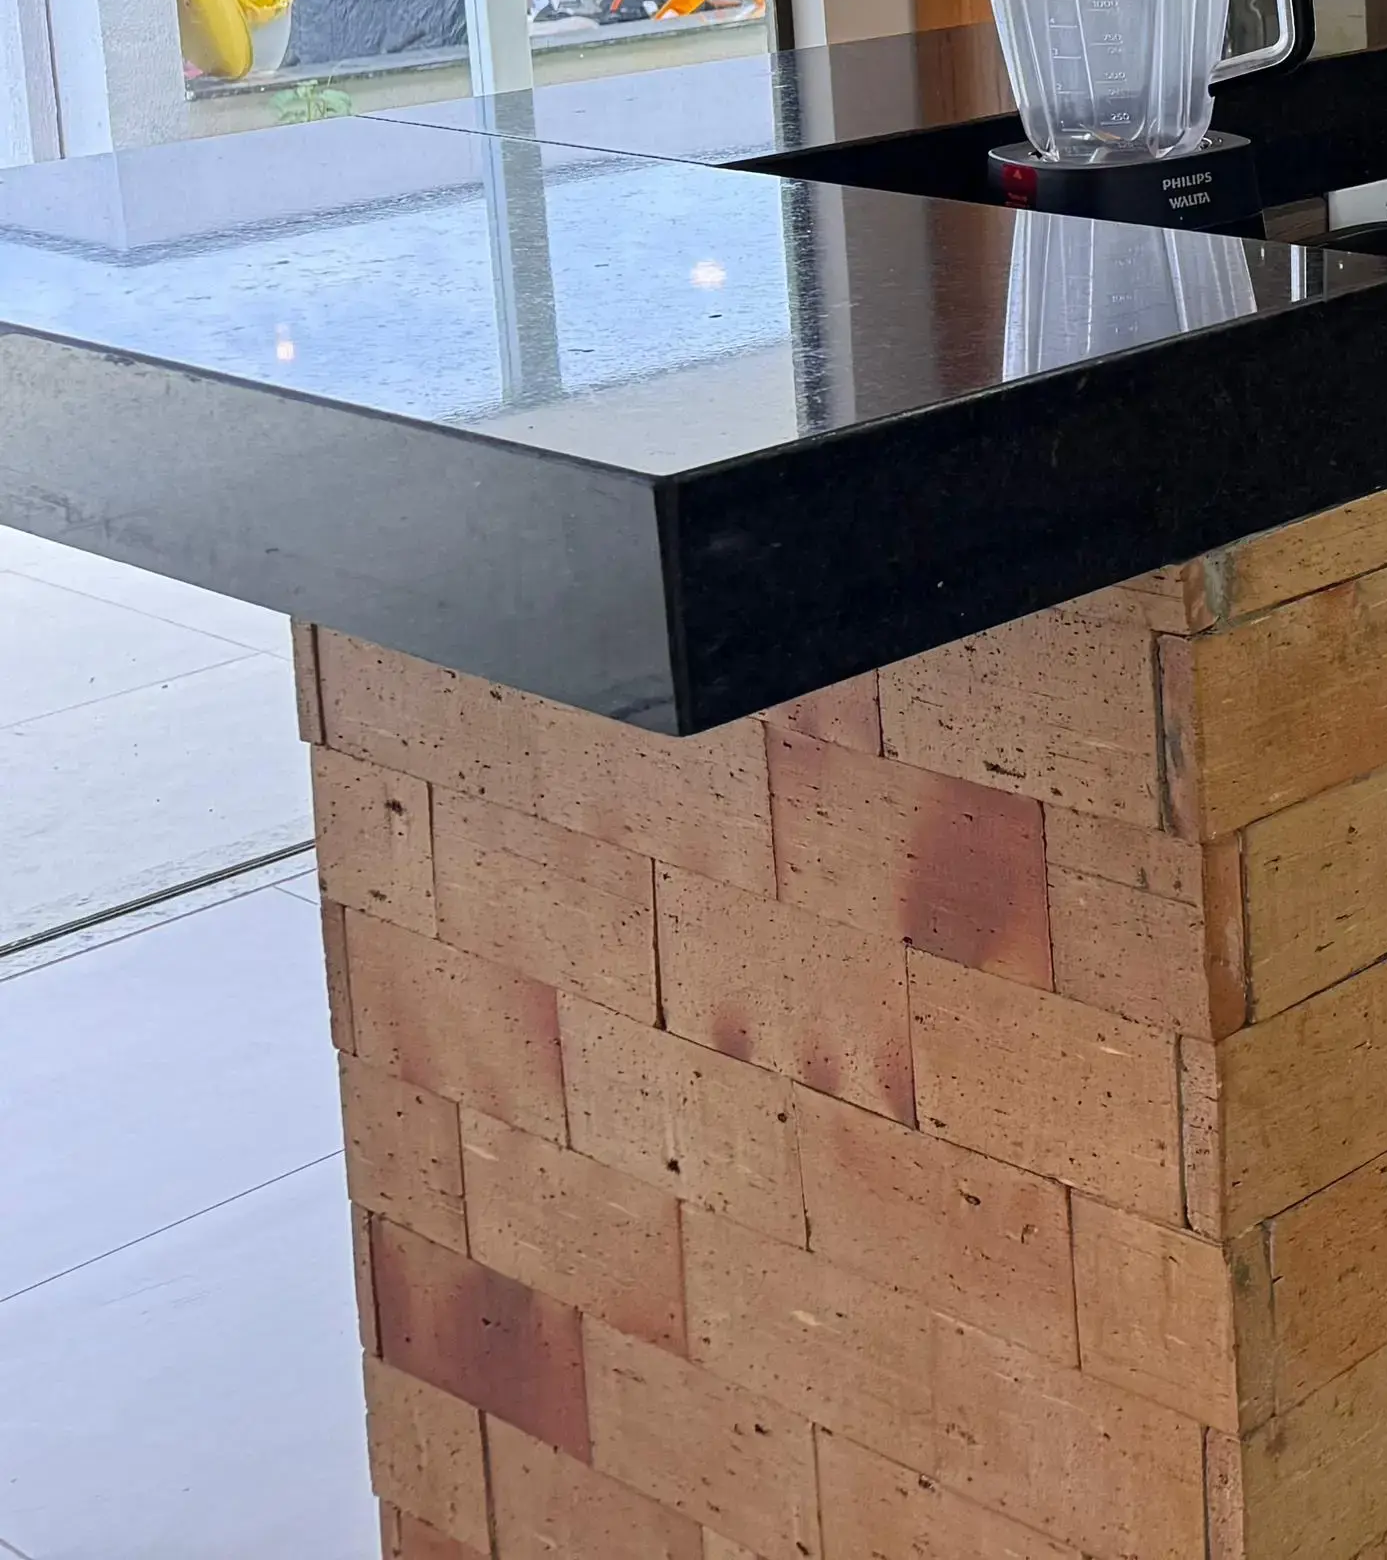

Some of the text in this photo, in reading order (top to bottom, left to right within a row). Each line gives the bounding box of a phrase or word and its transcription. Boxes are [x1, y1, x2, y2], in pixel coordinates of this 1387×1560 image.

[1110, 112, 1131, 121] 250
[1162, 171, 1213, 190] PHILIPS
[1168, 191, 1211, 209] WALITA
